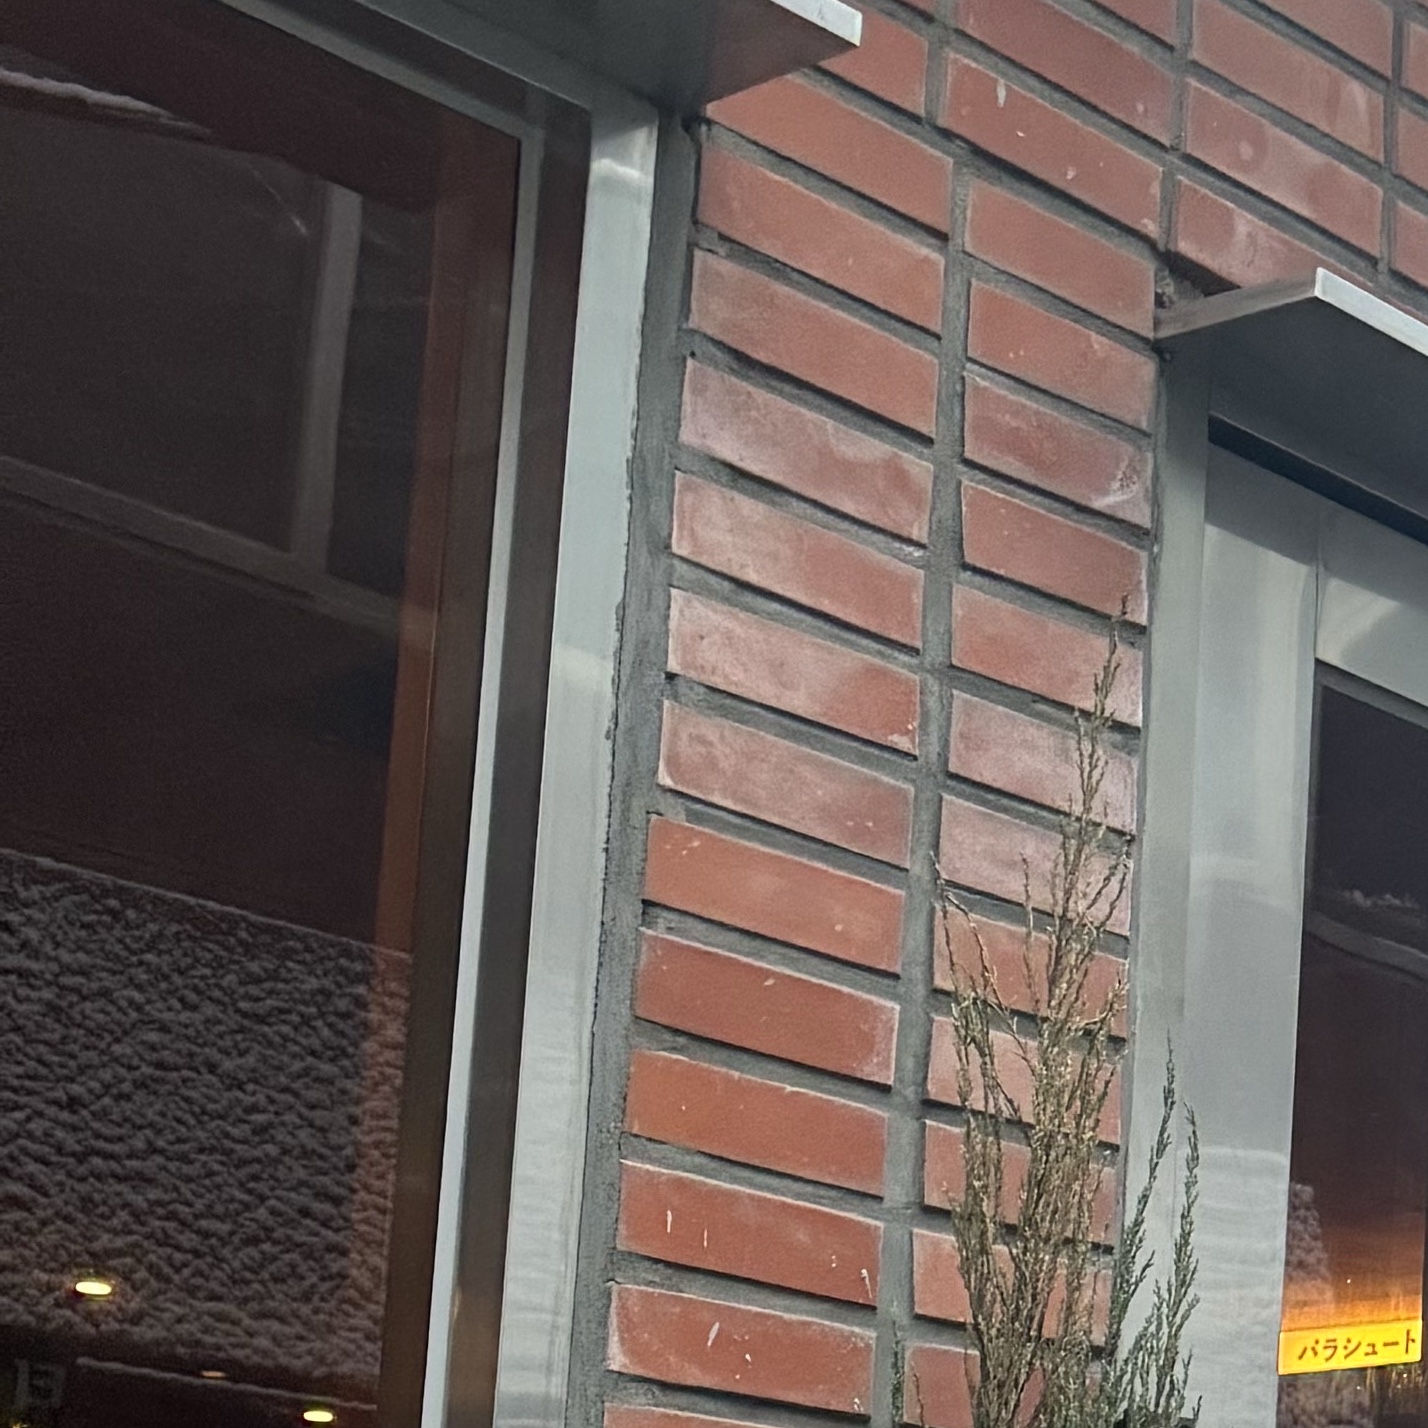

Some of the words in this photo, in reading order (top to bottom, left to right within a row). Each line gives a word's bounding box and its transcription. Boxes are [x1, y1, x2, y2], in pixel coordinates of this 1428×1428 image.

[1298, 1328, 1416, 1362] パラシュート
